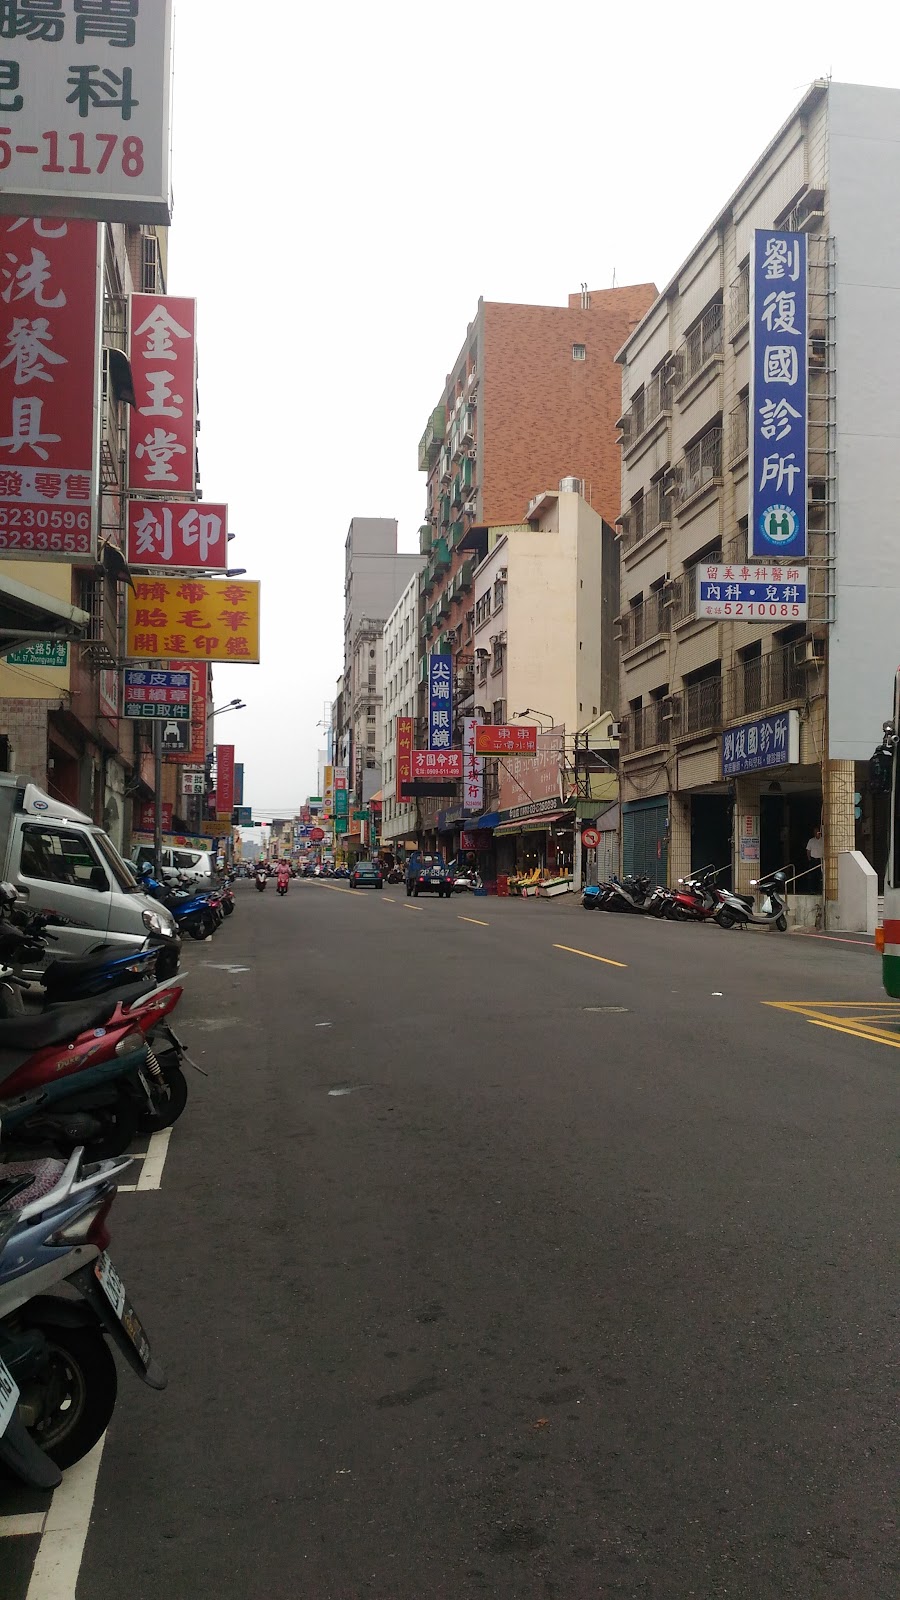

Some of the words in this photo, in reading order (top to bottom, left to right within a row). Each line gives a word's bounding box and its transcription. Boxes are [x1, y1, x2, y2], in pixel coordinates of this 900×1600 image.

[758, 236, 803, 497] 劉復國診所
[133, 303, 192, 482] 金玉堂
[0, 508, 89, 530] 5230596
[0, 530, 89, 552] 5233553
[133, 507, 222, 561] 刻印
[706, 565, 800, 582] 留美專科醫師
[135, 582, 252, 606] 臍帶章
[134, 607, 251, 631] 胎毛筆
[133, 633, 252, 656] 開運印鑑
[128, 671, 188, 687] 橡皮章
[127, 687, 188, 702] 連續章
[432, 661, 450, 748] 尖端眼鏡
[126, 703, 188, 717] 當日取件
[399, 720, 411, 776] 新竹一信
[493, 740, 535, 750] 平價水果
[723, 718, 788, 762] 劉復國診所
[415, 753, 459, 767] 方圓命理
